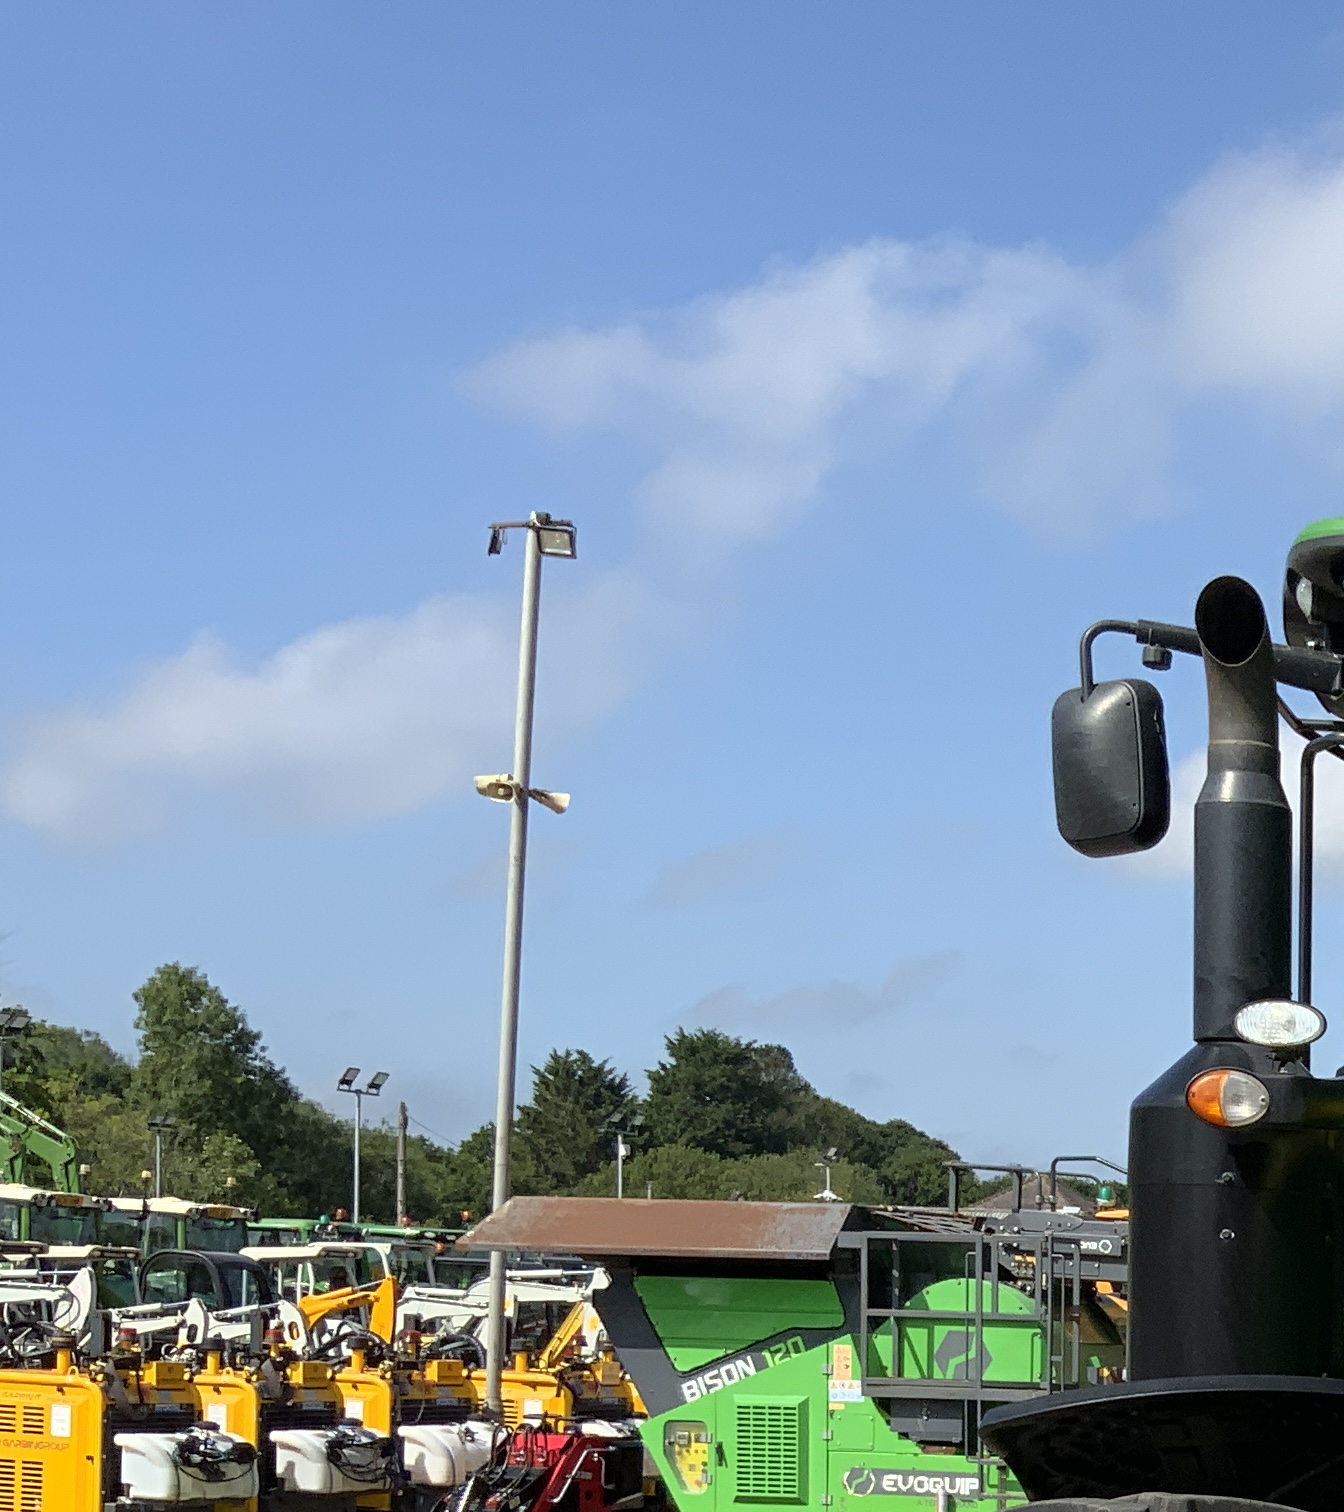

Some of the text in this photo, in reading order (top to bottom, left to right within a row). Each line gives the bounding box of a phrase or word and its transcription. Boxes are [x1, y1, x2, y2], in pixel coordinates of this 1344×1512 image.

[681, 1335, 807, 1403] BISON 120
[882, 1474, 980, 1496] EVOQUIP
